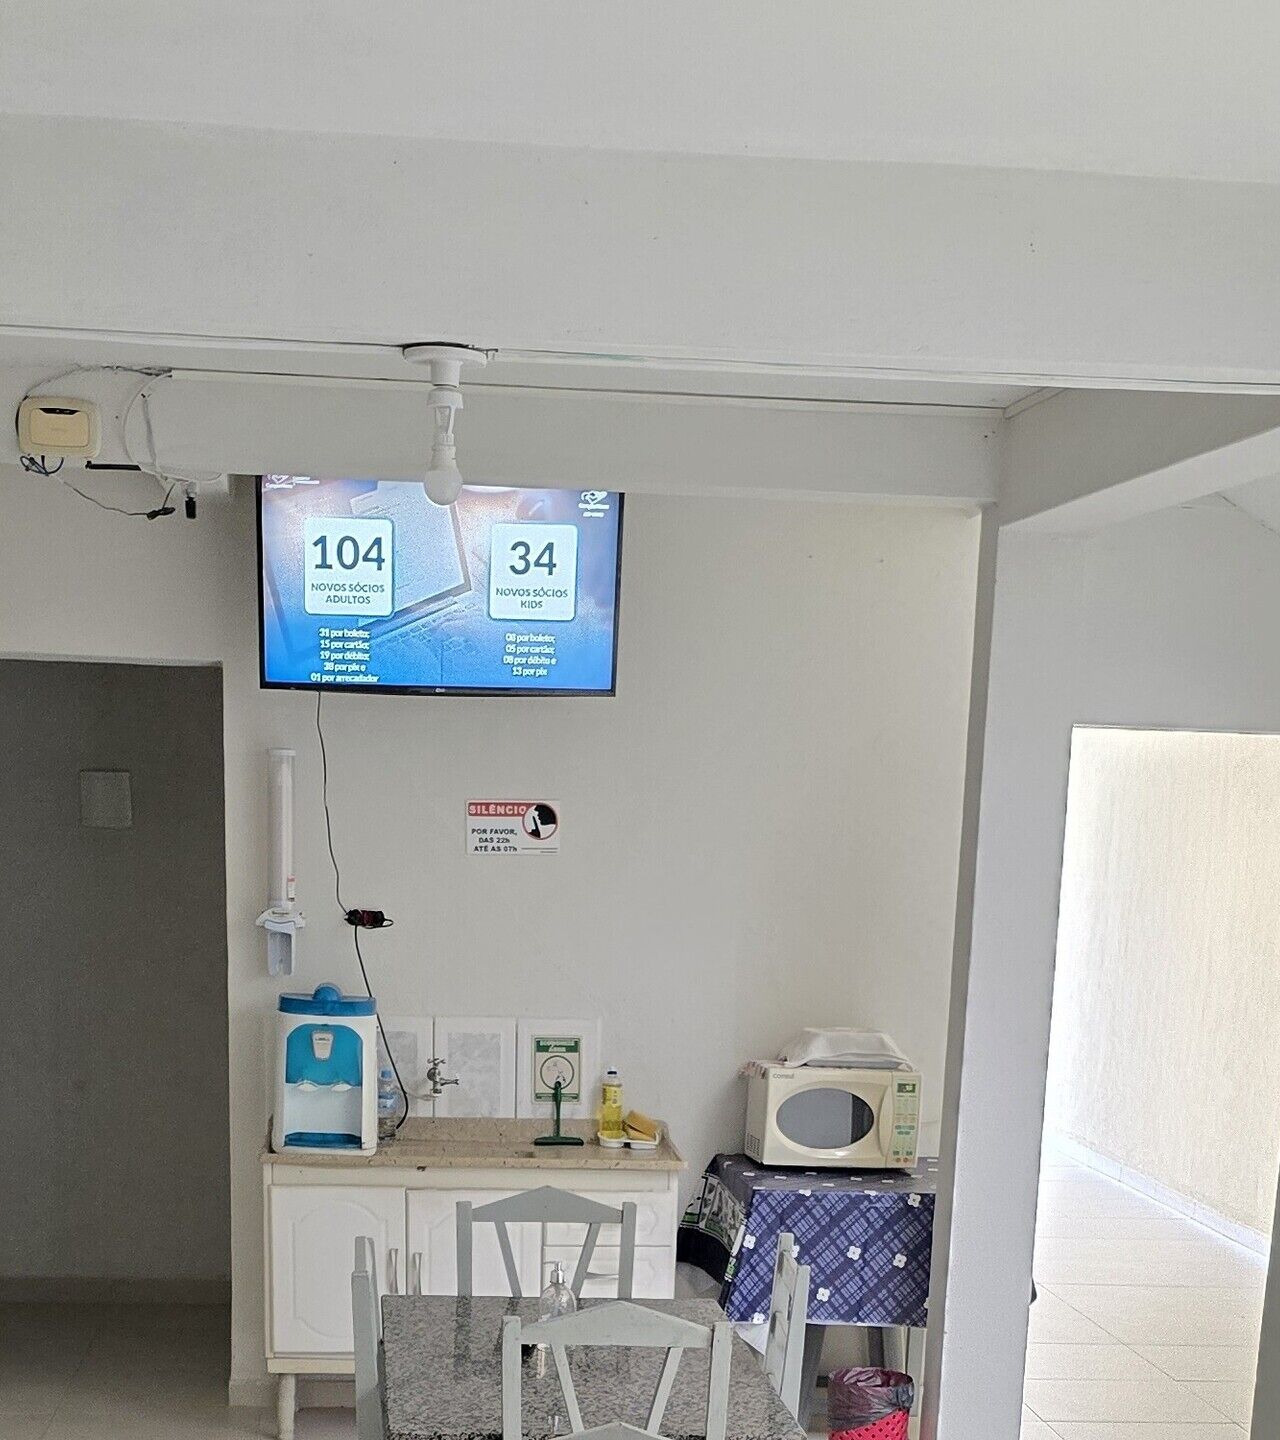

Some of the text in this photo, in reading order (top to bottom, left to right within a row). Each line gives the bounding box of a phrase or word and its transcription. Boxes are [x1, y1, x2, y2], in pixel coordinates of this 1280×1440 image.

[312, 535, 385, 571] 104
[509, 541, 557, 576] 34
[311, 581, 385, 593] NOVOS SÓCIOS
[495, 586, 569, 598] NOVOS SÓCIOS
[325, 595, 371, 604] ADULTOS
[520, 600, 543, 609] KIDS
[330, 630, 344, 638] por
[516, 635, 530, 643] por
[330, 641, 344, 649] por
[516, 646, 530, 655] por
[330, 653, 344, 661] por
[514, 657, 527, 665] por
[334, 664, 347, 672] por
[523, 669, 536, 677] por
[322, 675, 335, 683] por
[468, 804, 527, 815] SILÊNCIO
[489, 828, 517, 836] FAVOR,
